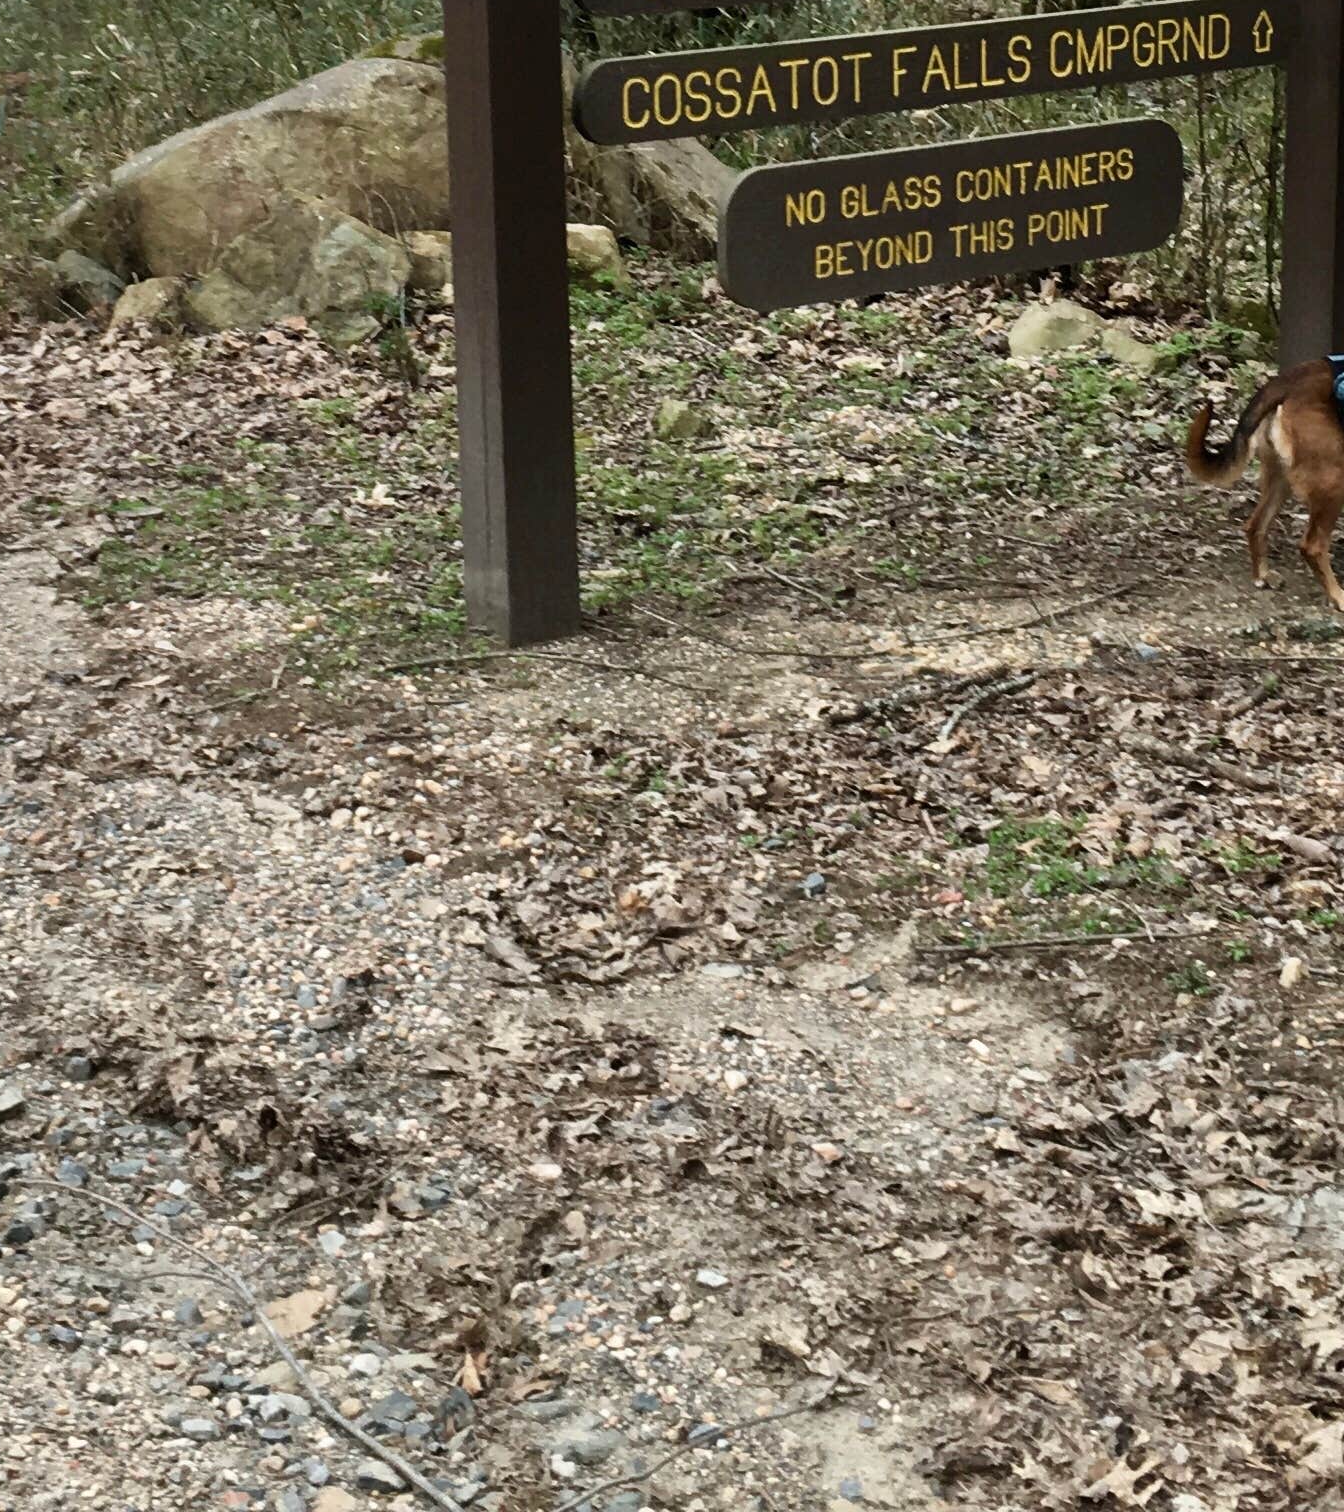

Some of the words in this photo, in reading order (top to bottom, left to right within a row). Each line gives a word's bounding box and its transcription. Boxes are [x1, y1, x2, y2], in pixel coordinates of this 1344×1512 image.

[623, 52, 872, 128] COSSATOT
[892, 37, 1034, 98] FALLS
[1050, 14, 1230, 77] CMPGRND
[786, 189, 825, 227] NO
[841, 175, 941, 218] GLASS
[956, 148, 1134, 205] CONTAINERS
[815, 231, 932, 279] BEYOND
[949, 218, 1014, 256] THIS
[1028, 205, 1107, 246] POINT
